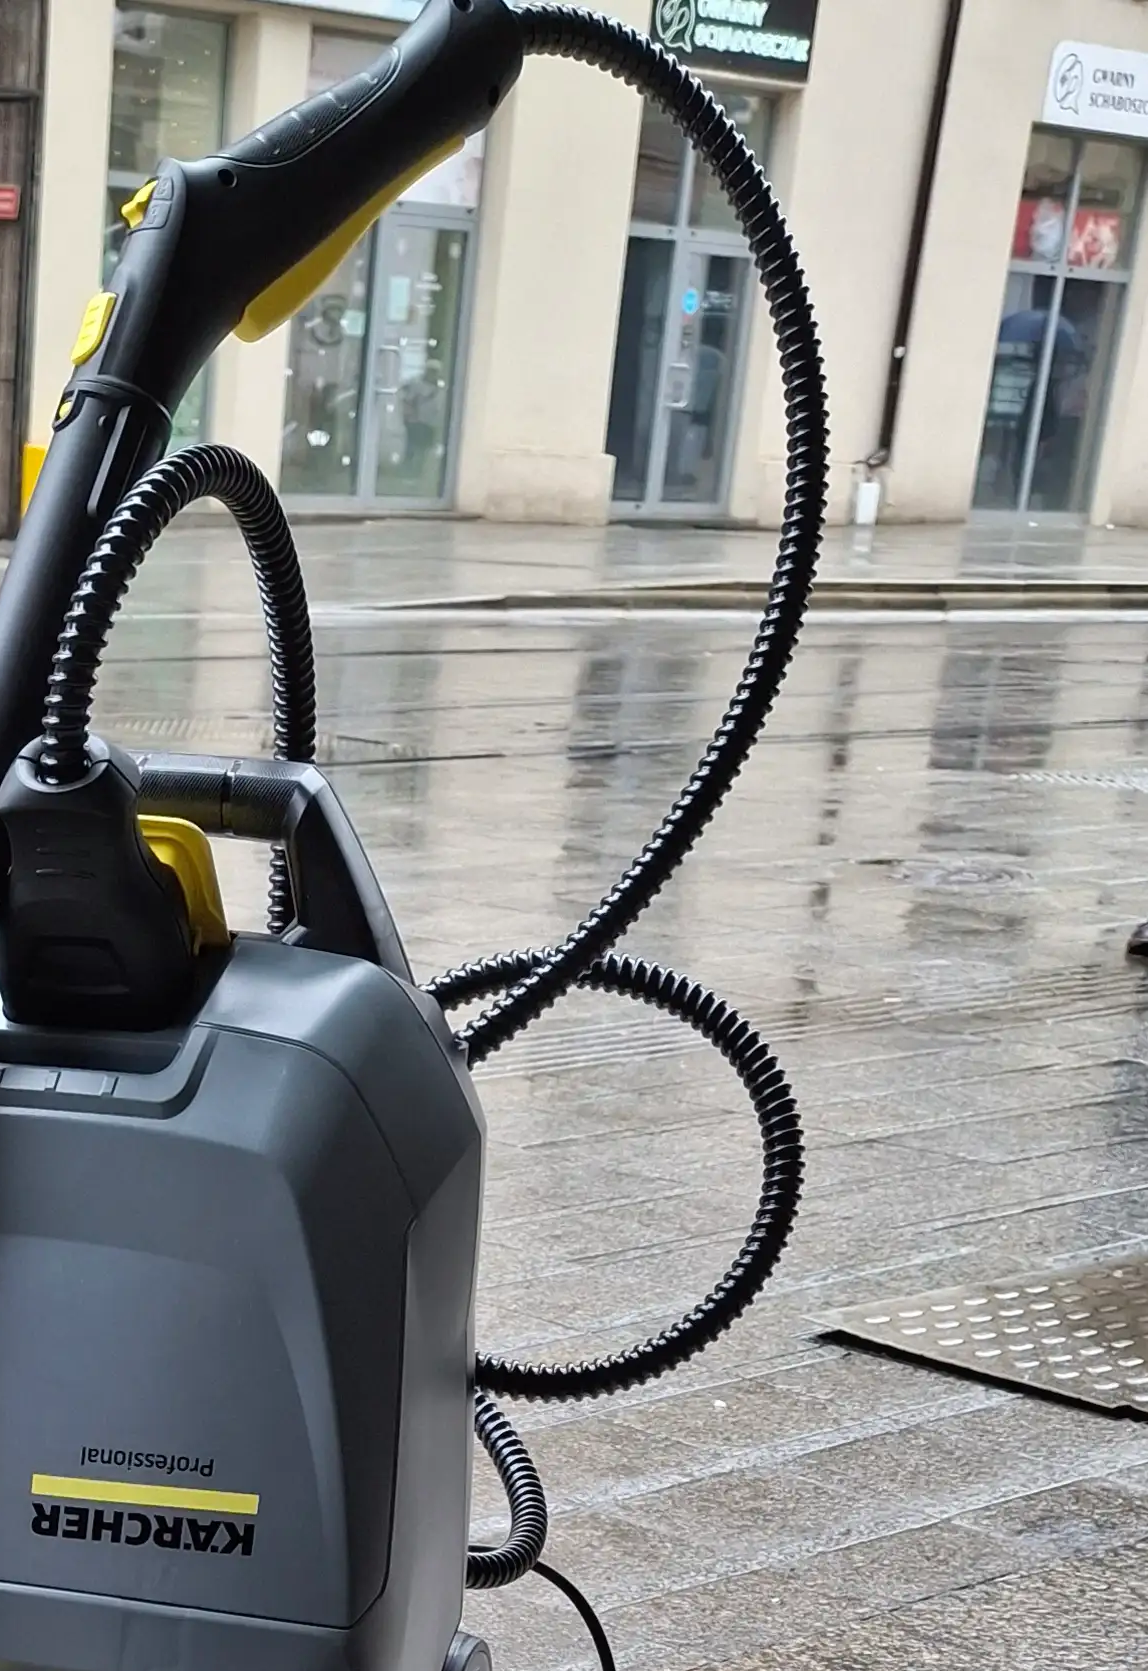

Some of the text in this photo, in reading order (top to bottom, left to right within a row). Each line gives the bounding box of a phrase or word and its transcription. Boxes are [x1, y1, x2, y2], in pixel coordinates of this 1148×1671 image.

[1092, 68, 1135, 89] GWARNY
[80, 1446, 215, 1478] Professional
[31, 1502, 256, 1557] KÄRCHER
